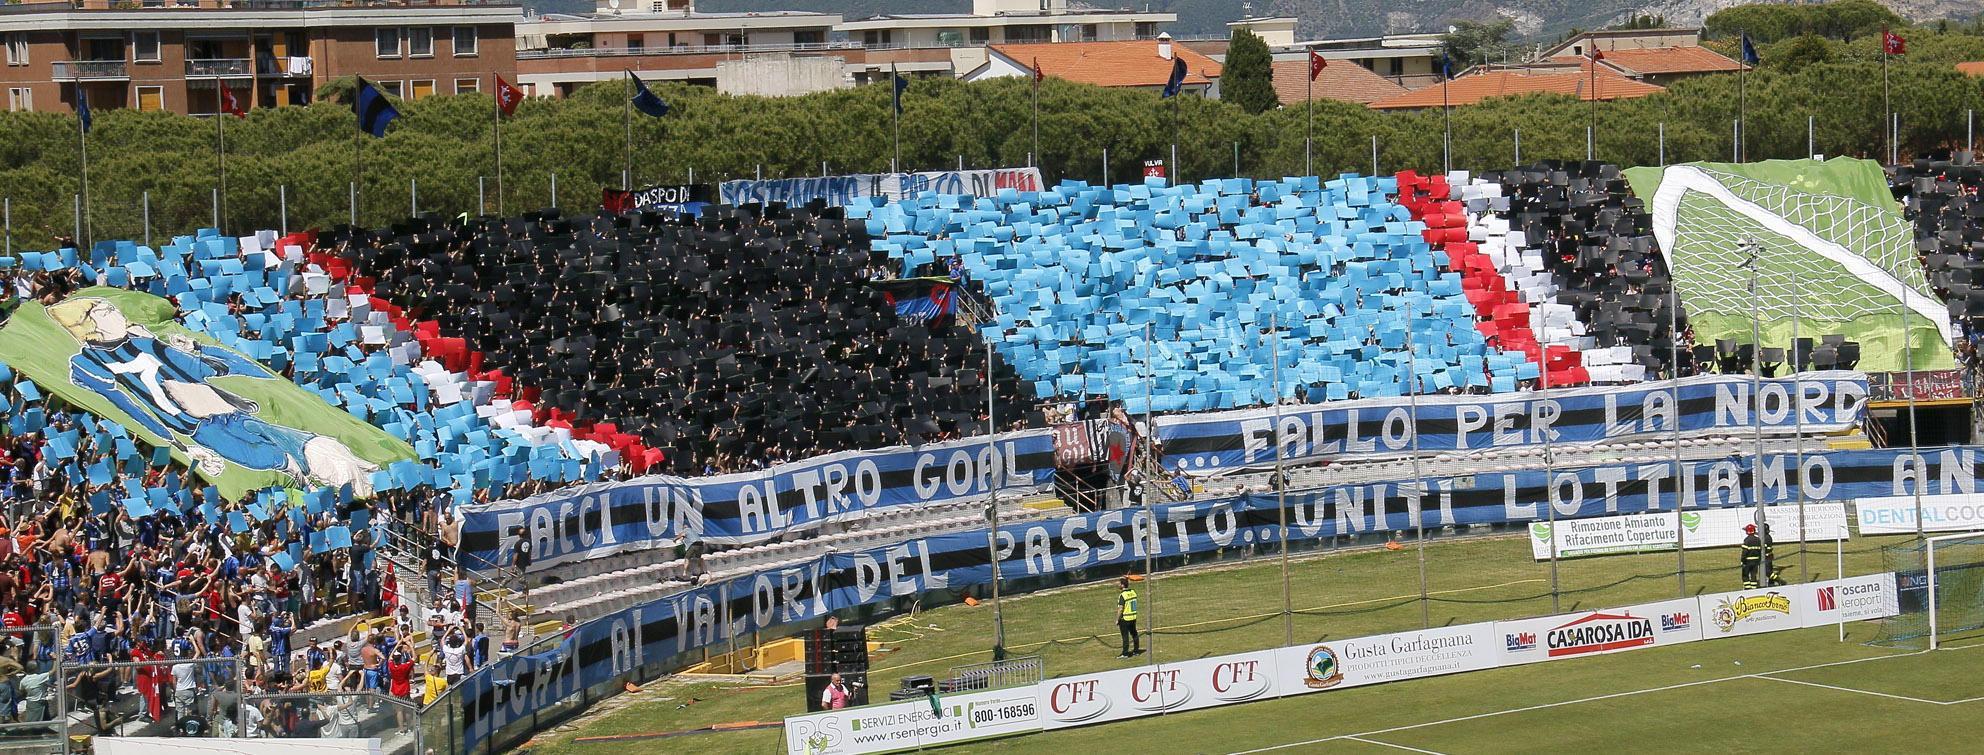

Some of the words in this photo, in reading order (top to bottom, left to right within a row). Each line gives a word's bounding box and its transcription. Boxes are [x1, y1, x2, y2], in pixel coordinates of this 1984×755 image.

[634, 187, 676, 208] DASPO
[680, 186, 690, 203] DI
[972, 174, 989, 198] DI
[1240, 408, 1412, 463] FALLO
[1455, 400, 1562, 449] PER
[1604, 388, 1676, 438] LA
[1715, 380, 1868, 425] NORD
[497, 493, 617, 566] FACCI
[643, 487, 704, 537] UN
[738, 459, 882, 533] ALTRO
[913, 442, 1034, 499] GOAL
[1571, 518, 1621, 532] Rimozione
[1625, 516, 1665, 529] Amianto
[1565, 532, 1624, 546] Rifacimento
[1627, 529, 1675, 543] Coperture
[611, 609, 643, 676] AI
[672, 563, 828, 651] VALORI
[853, 540, 948, 602] DEL
[1295, 479, 1456, 536] UNITI
[1504, 454, 1833, 518] LOTTIAMO
[1893, 450, 1975, 495] AN
[1661, 612, 1690, 627] BigMat
[1506, 632, 1536, 648] BigMat
[1547, 623, 1625, 648] CASAROSA
[1628, 619, 1653, 639] IDA
[174, 643, 181, 656] 5
[1345, 643, 1386, 660] Gusta
[1391, 634, 1473, 654] Garfagnana
[1212, 660, 1259, 693] CFT
[1347, 658, 1388, 672] PRODOTTI
[1050, 679, 1099, 714] CFT
[1132, 669, 1181, 703] CFT
[862, 715, 896, 728] SERVIZI
[898, 707, 953, 724] ENERGEICI
[974, 703, 1035, 723] 800-168596
[854, 720, 962, 744] www.rsenergia.it
